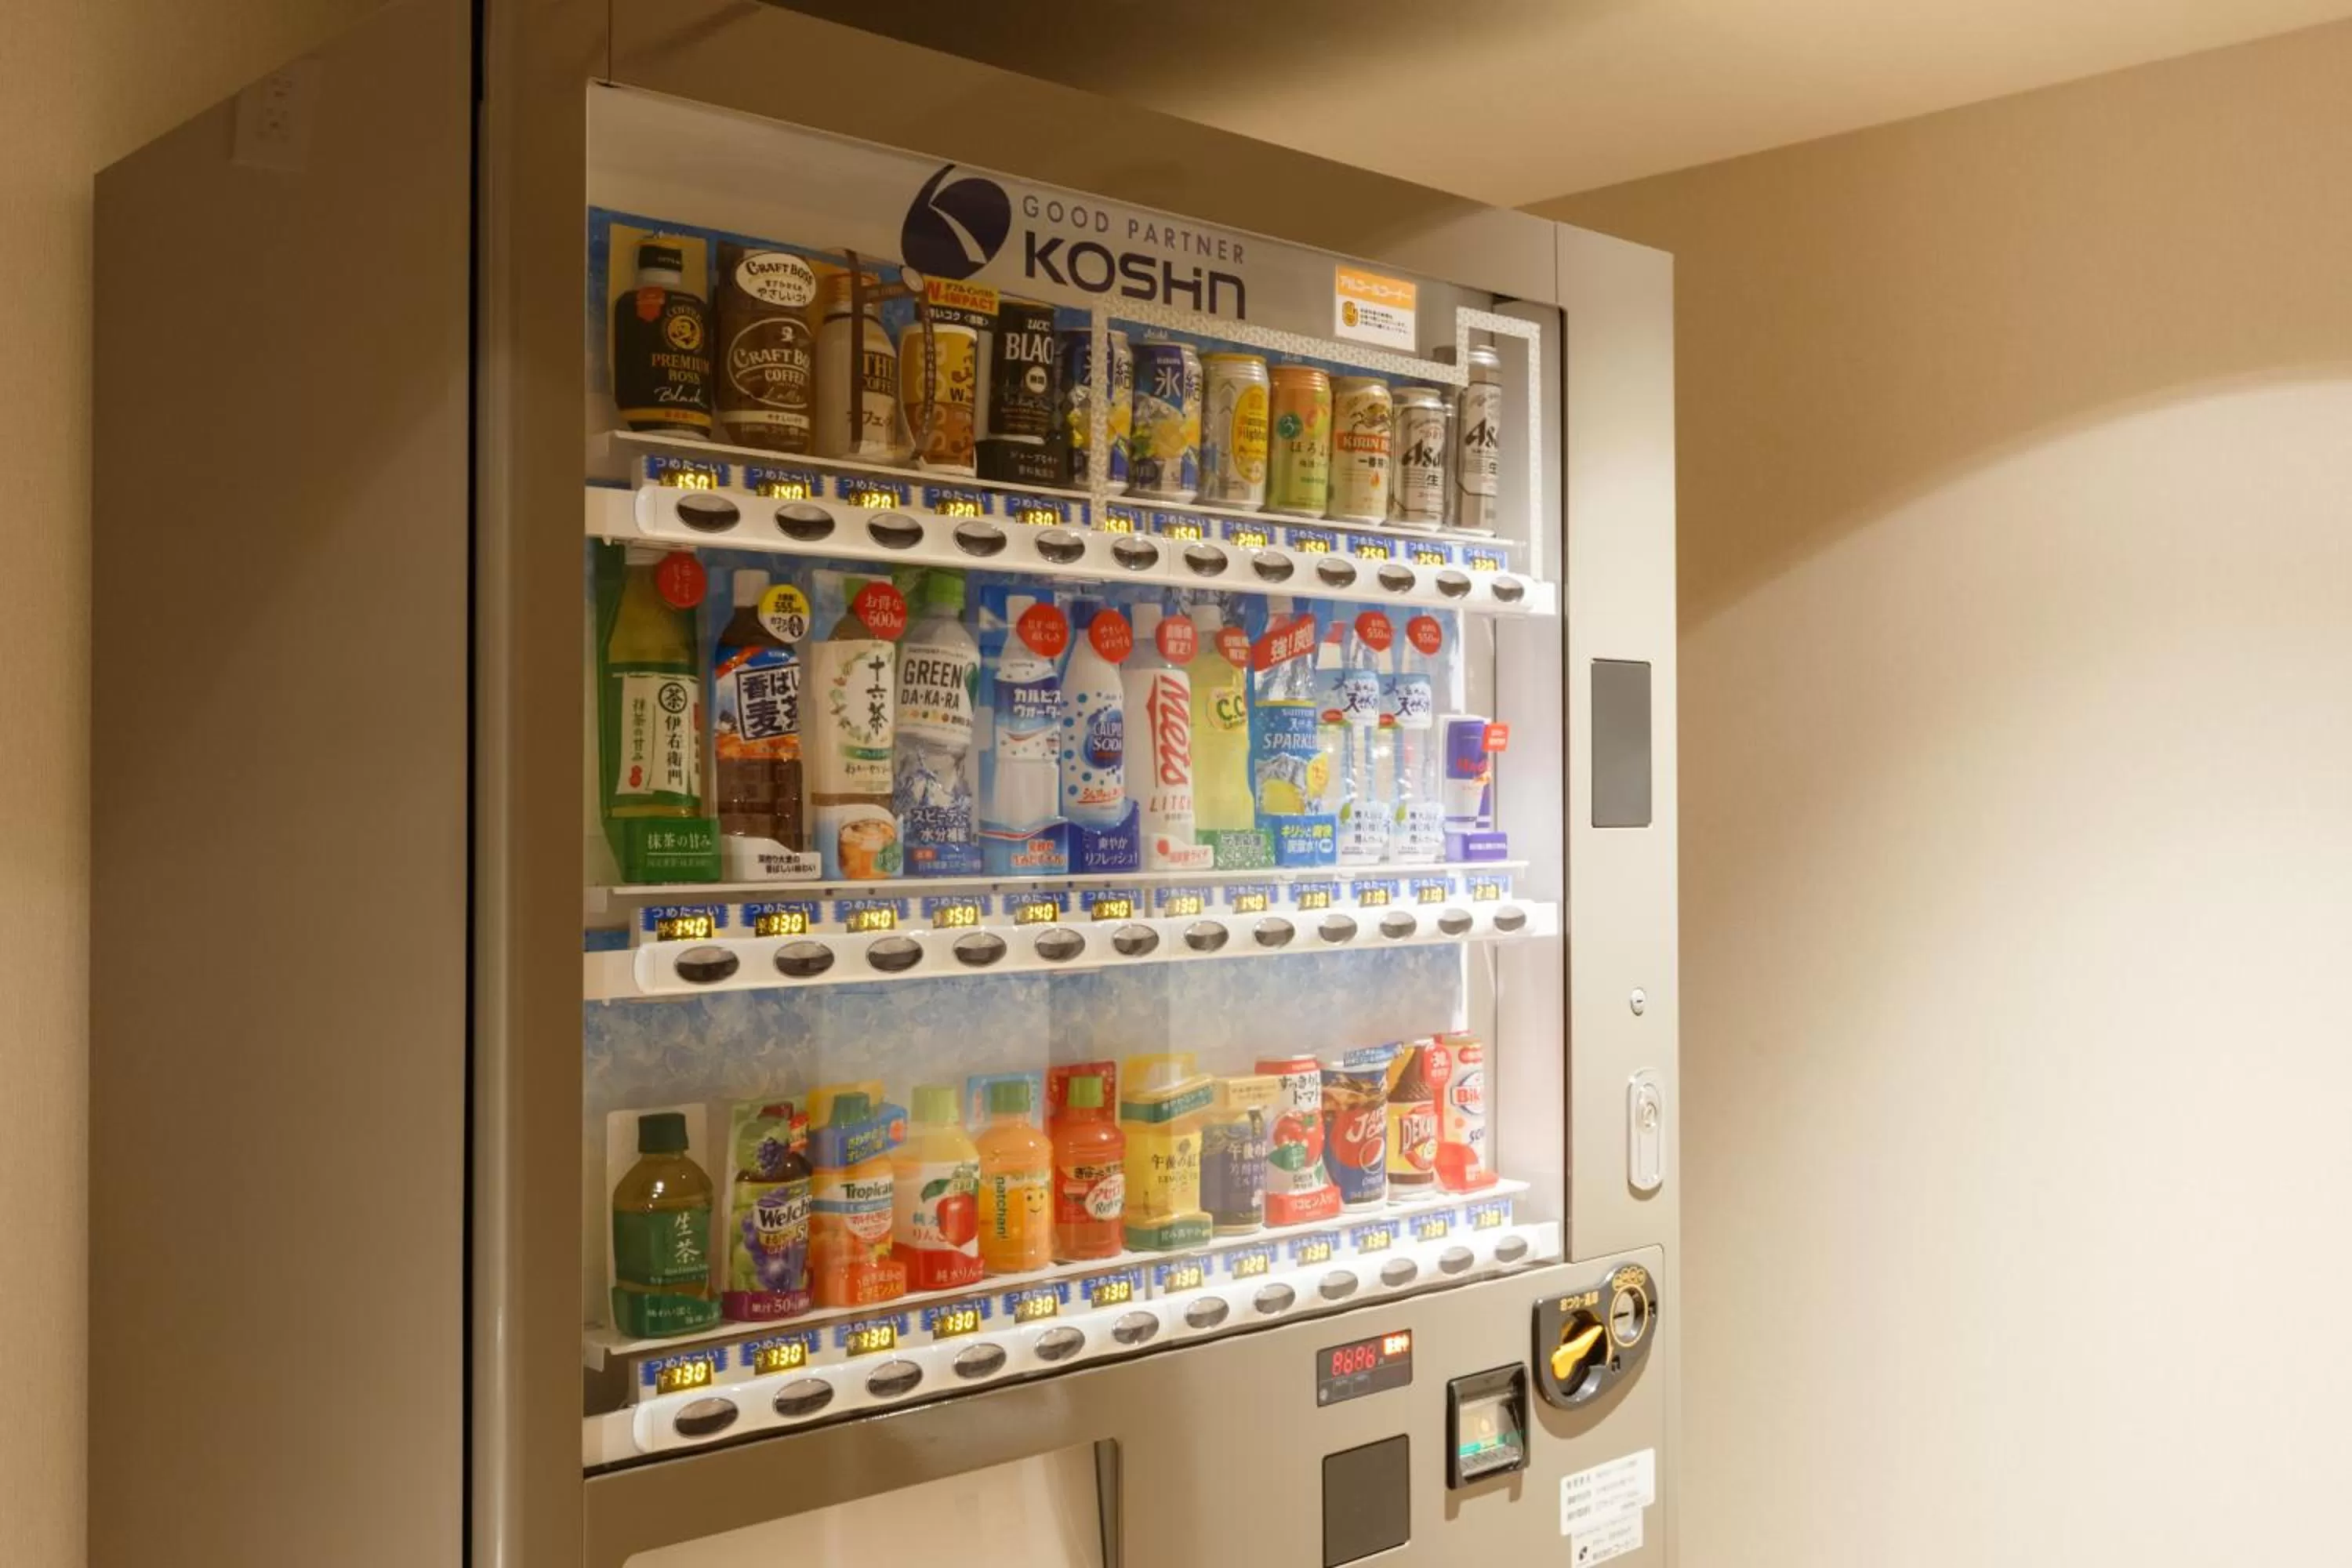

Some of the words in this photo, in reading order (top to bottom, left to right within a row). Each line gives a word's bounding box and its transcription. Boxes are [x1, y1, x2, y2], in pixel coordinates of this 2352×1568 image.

[1022, 195, 1109, 234] GOOD
[1128, 219, 1245, 265] PARTNER
[866, 655, 887, 736] 十六茶
[904, 658, 964, 691] GREEN
[647, 833, 713, 850] 抹茶の甘み
[674, 1211, 701, 1265] 生茶
